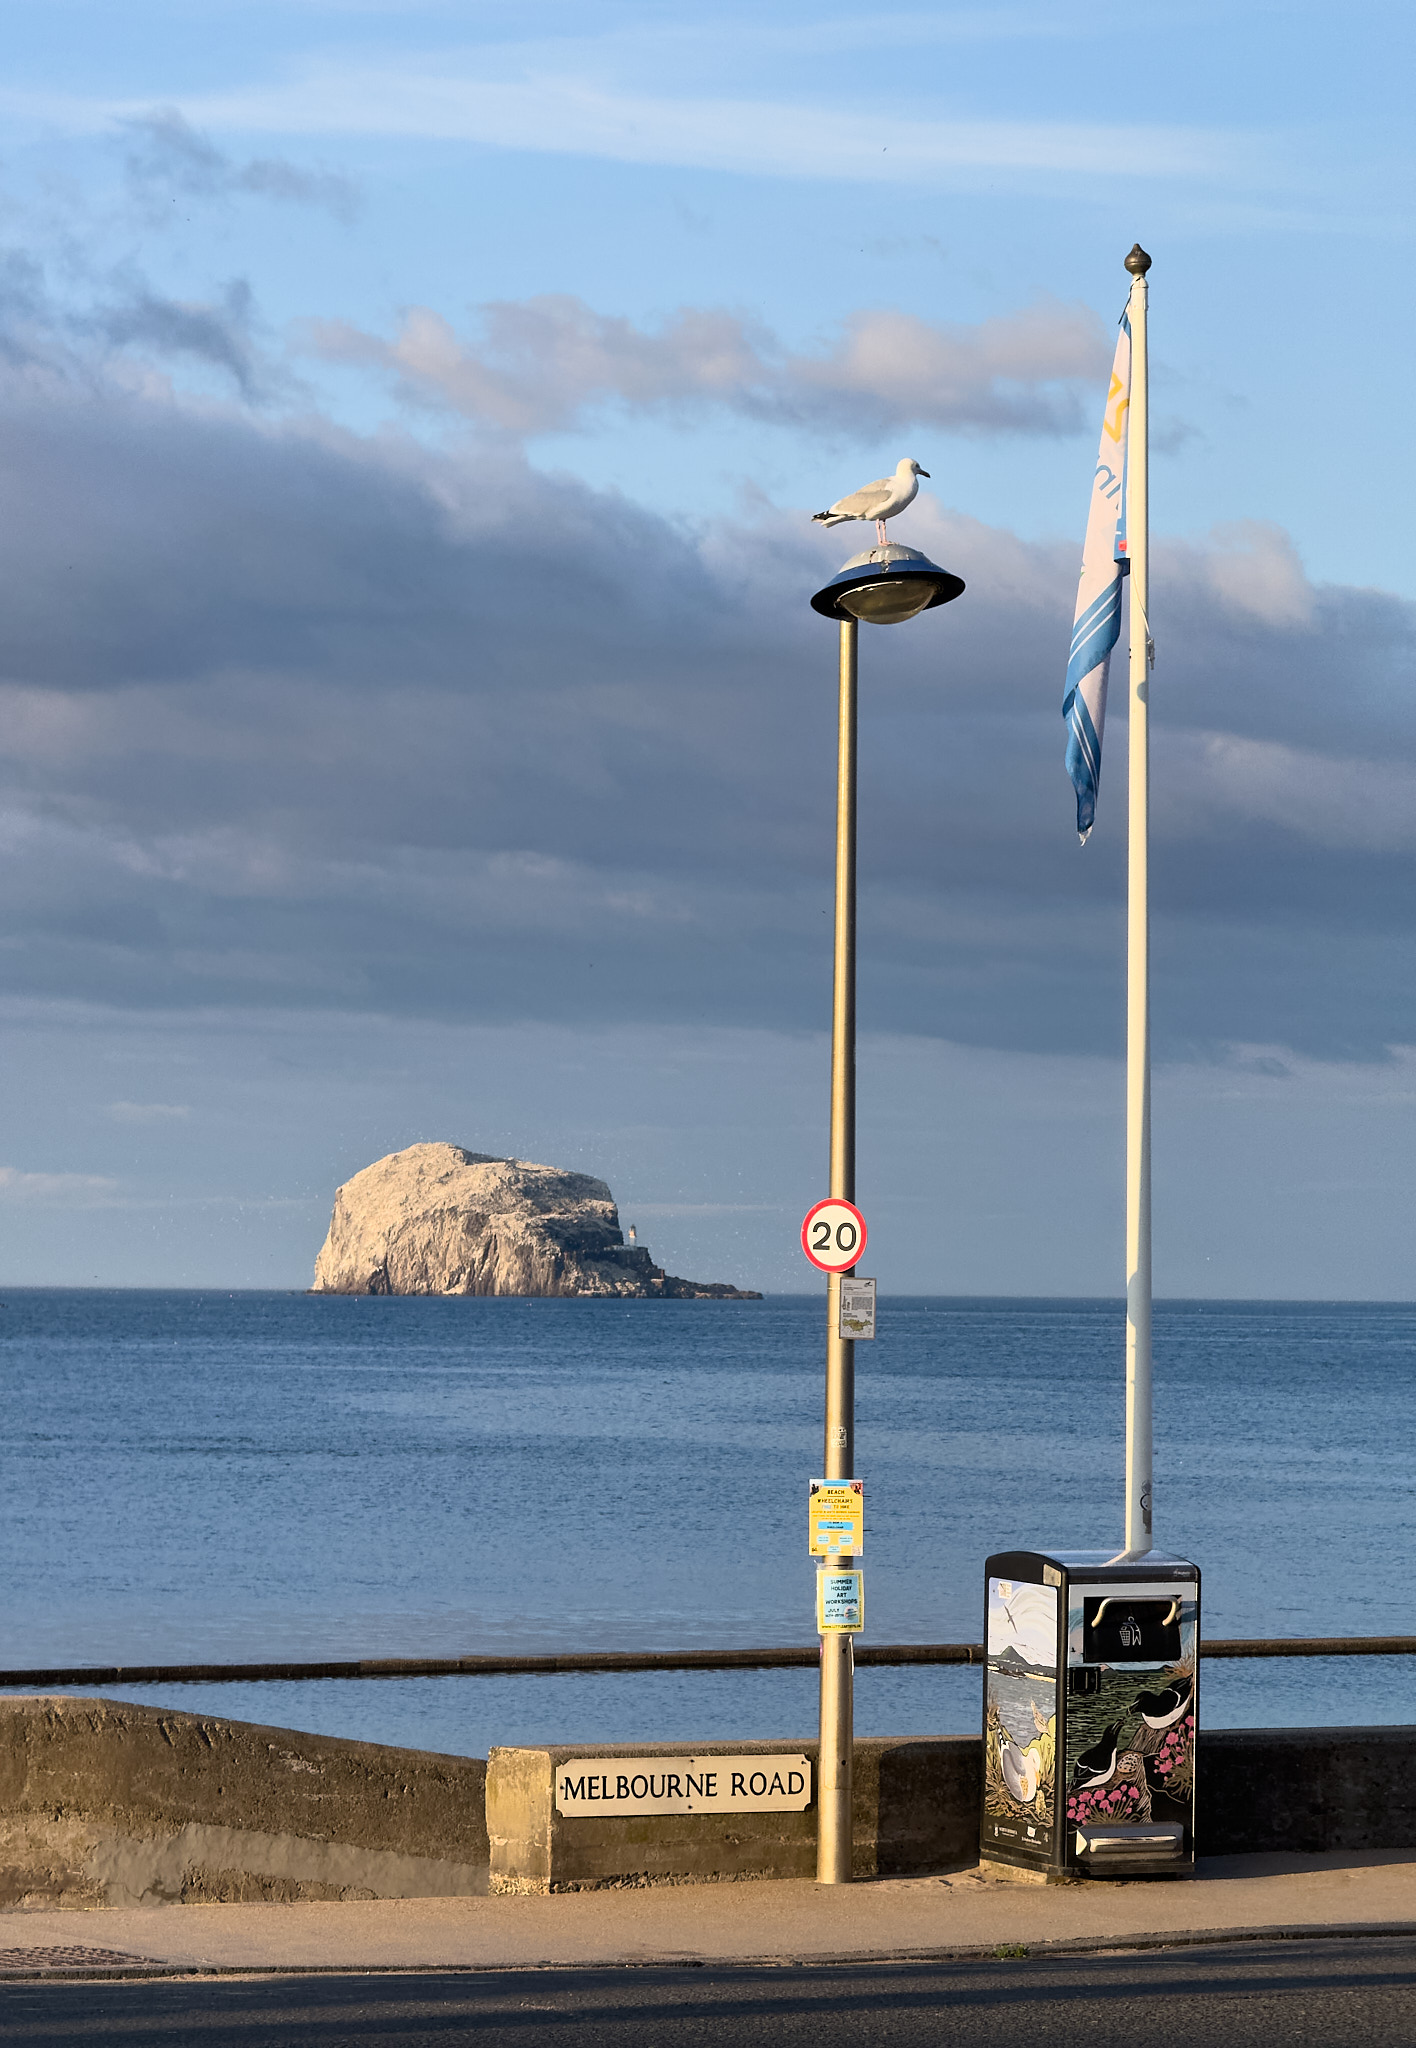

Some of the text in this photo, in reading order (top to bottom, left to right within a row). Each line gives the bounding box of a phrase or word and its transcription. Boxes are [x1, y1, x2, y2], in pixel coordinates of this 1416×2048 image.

[812, 1221, 857, 1252] 20
[563, 1771, 805, 1801] MELBOURNE ROAD
